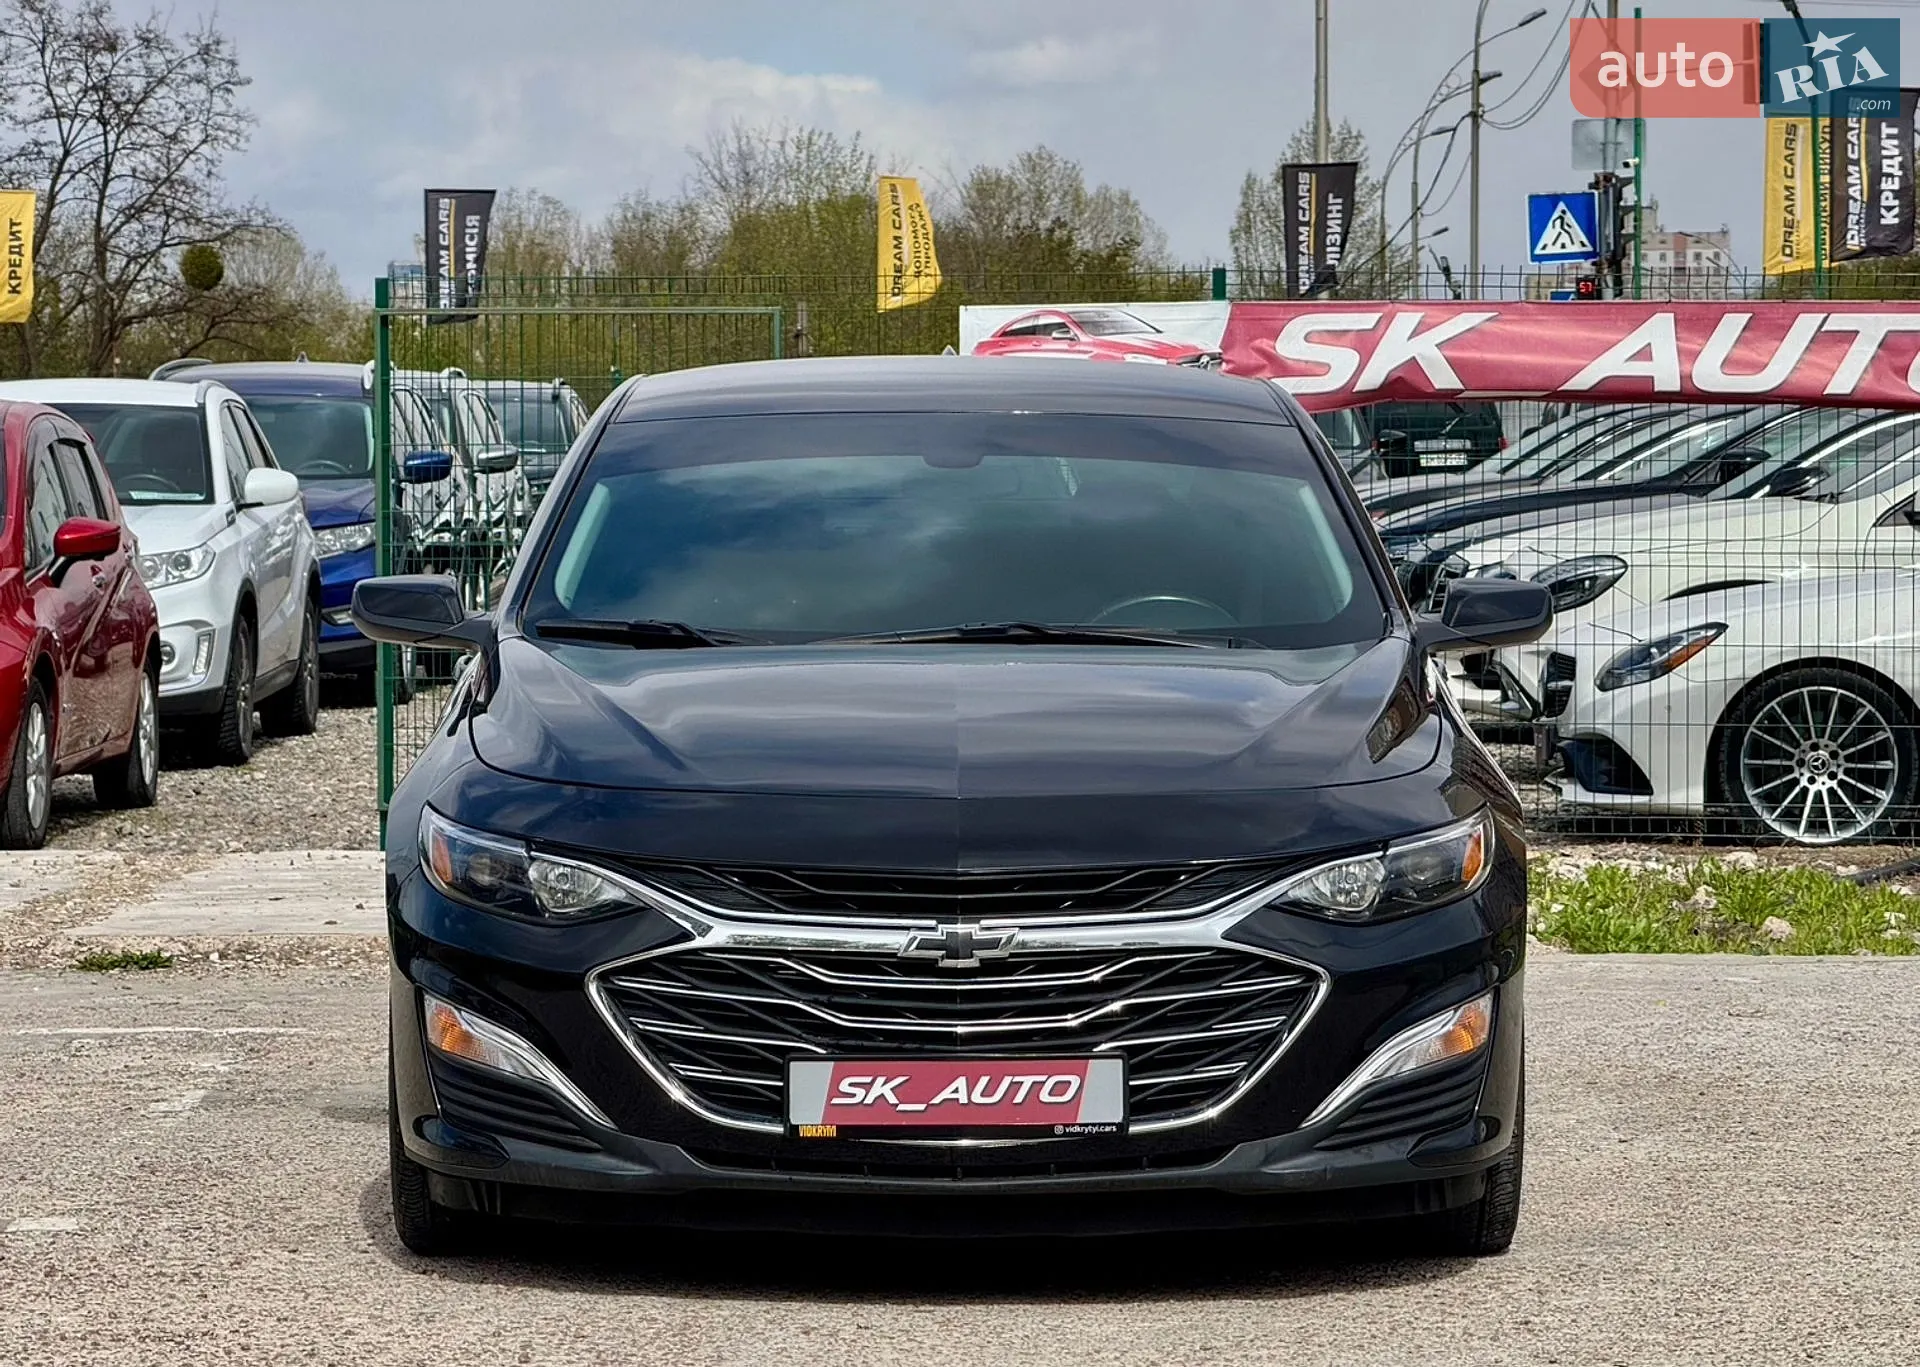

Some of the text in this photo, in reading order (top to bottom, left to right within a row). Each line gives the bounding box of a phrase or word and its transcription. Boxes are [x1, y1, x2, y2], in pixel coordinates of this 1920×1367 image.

[1782, 123, 1797, 258] DREAM CARS
[1846, 165, 1861, 246] DREAM
[1880, 122, 1903, 225] КРЕДИТ
[8, 217, 24, 294] КРЕДИТ
[439, 198, 450, 246] CARS
[889, 183, 903, 296] DREAM CARS
[908, 203, 923, 278] ДОПОМОГА
[914, 202, 931, 269] ПРОДАЖУ
[1298, 171, 1310, 290] DREAM CARS
[1326, 193, 1343, 267] ЛІЗИНГ
[1556, 312, 1920, 395] AUT
[830, 1074, 1082, 1112] SK_AUTO
